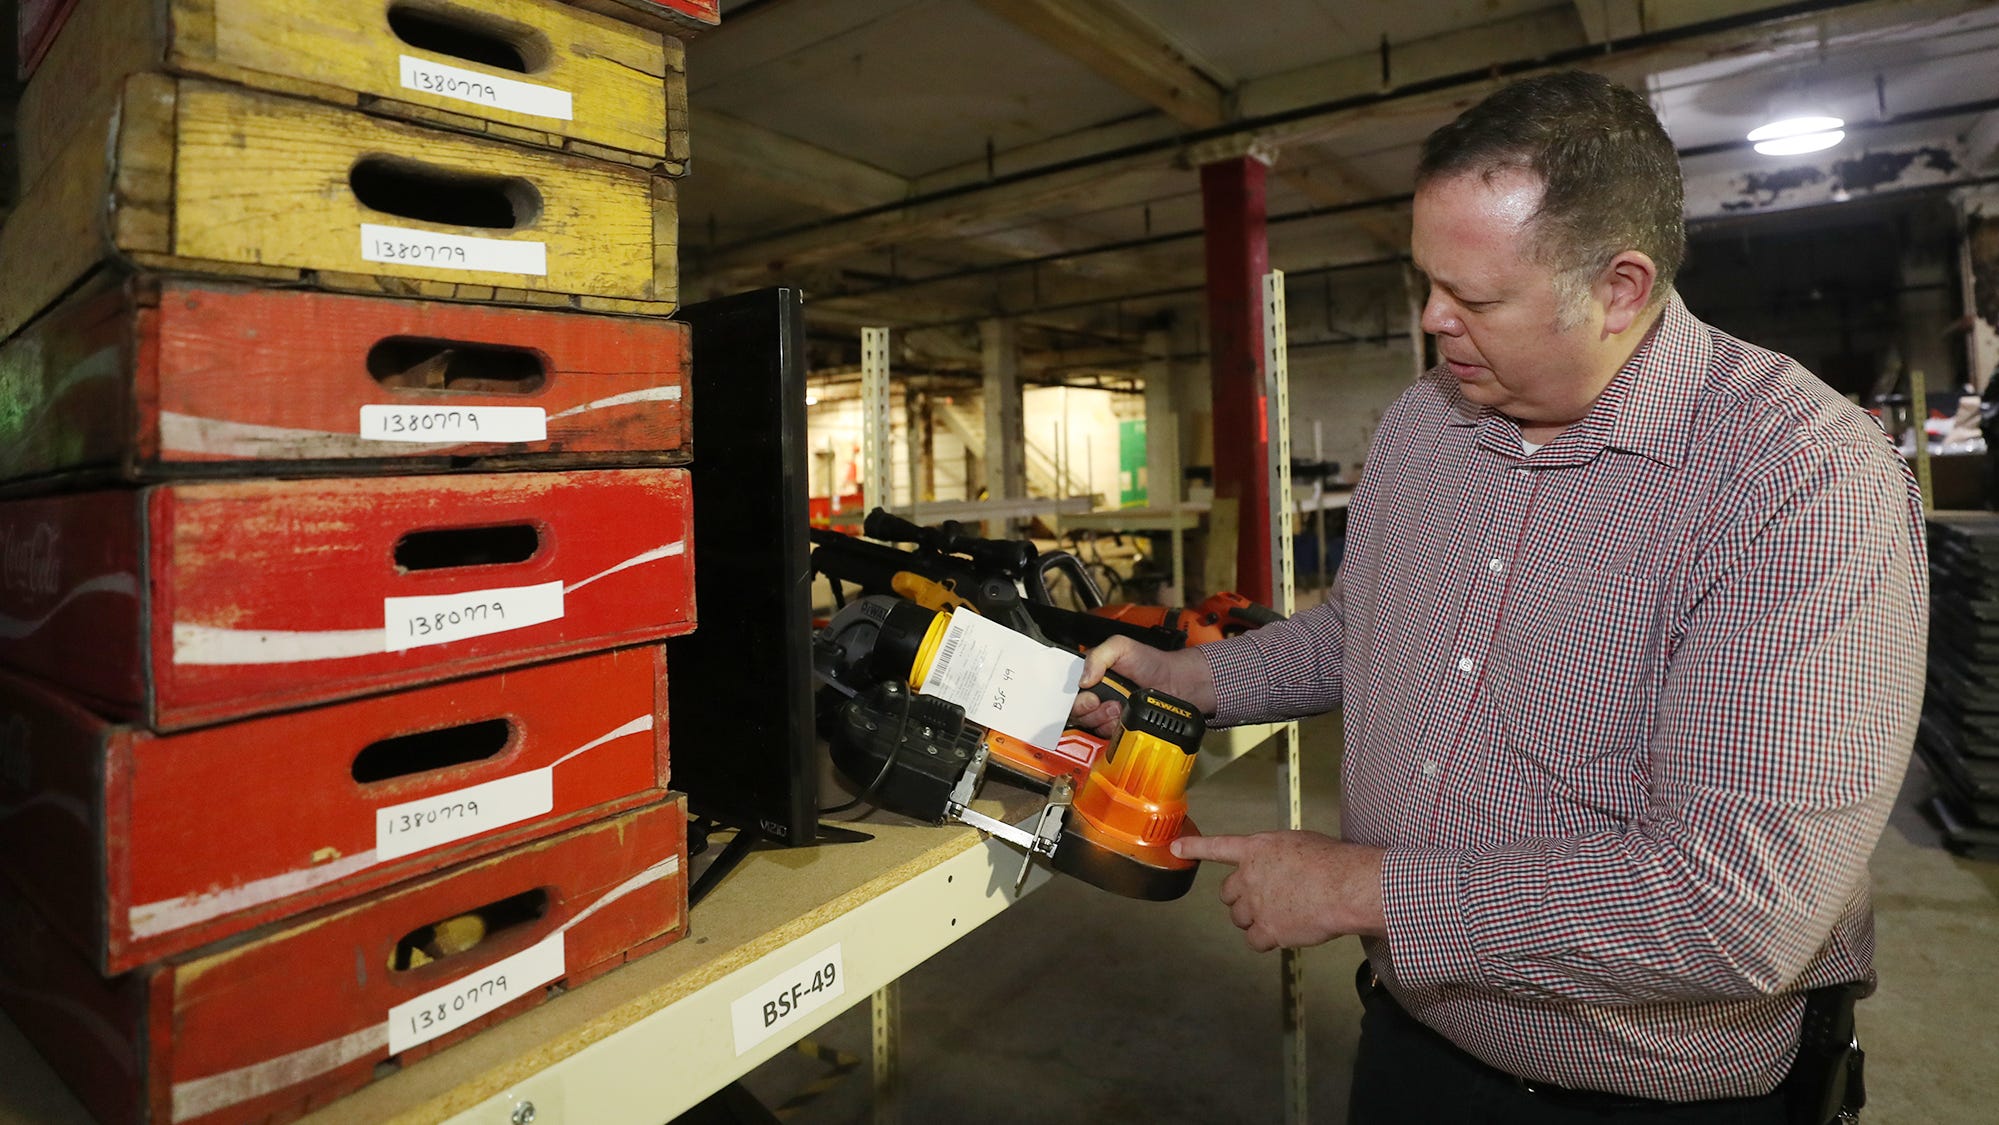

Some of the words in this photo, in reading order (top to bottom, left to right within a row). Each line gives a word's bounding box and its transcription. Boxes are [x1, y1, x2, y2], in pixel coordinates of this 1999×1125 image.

[413, 70, 497, 101] 1380779
[375, 240, 466, 263] 1380779
[383, 411, 480, 433] 1380779
[408, 601, 505, 637] 1380779
[992, 687, 1006, 711] BSF
[388, 800, 479, 835] 1380779
[410, 975, 508, 1035] 1380779
[762, 962, 837, 1028] BSF-49
